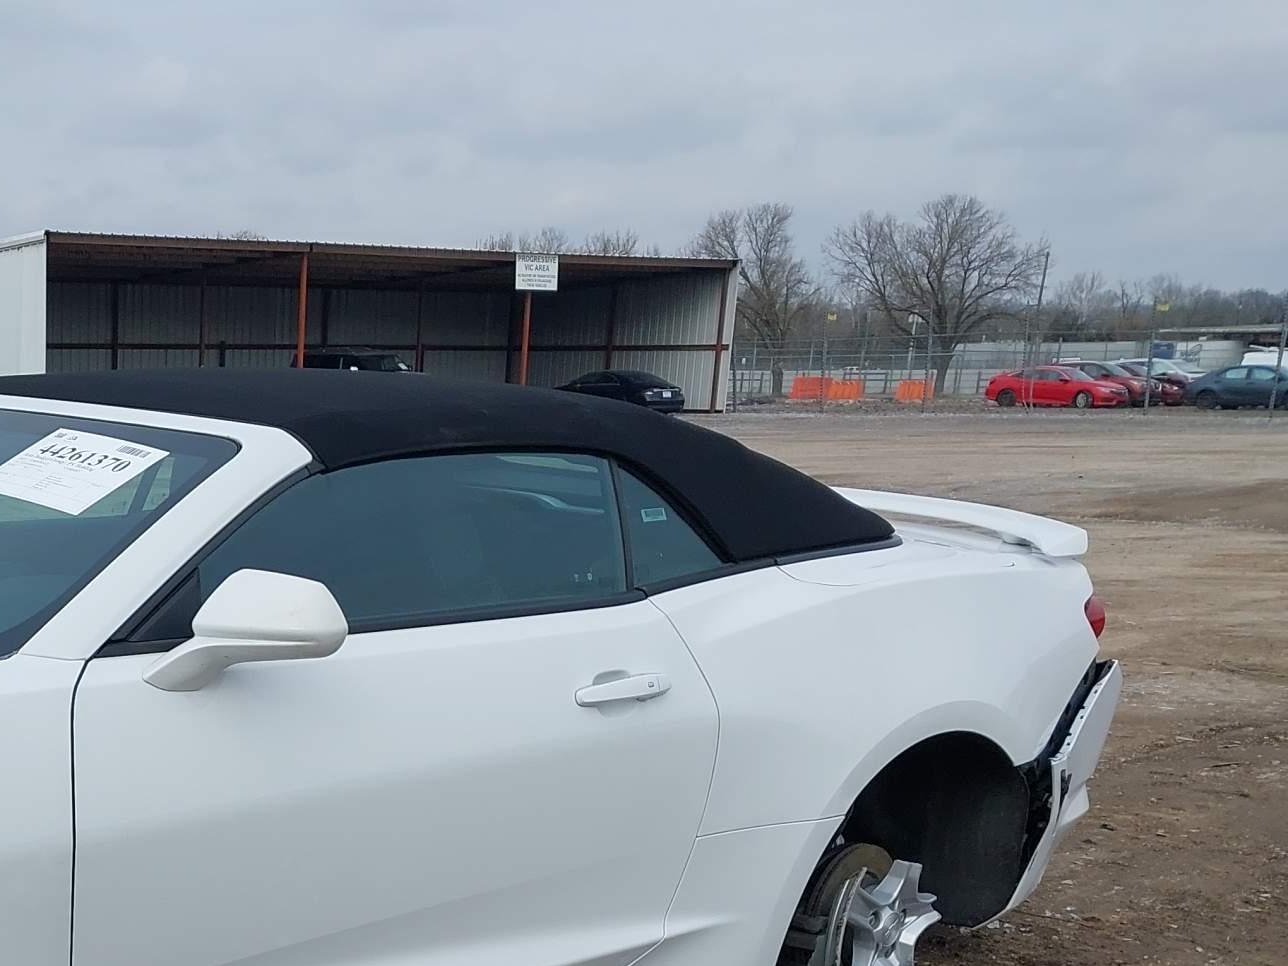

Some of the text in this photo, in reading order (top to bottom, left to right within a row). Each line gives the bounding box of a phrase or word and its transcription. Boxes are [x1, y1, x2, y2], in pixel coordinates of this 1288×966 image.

[518, 254, 557, 264] PROGRESSIVE
[535, 264, 550, 272] AREA
[39, 443, 131, 472] 44261370
